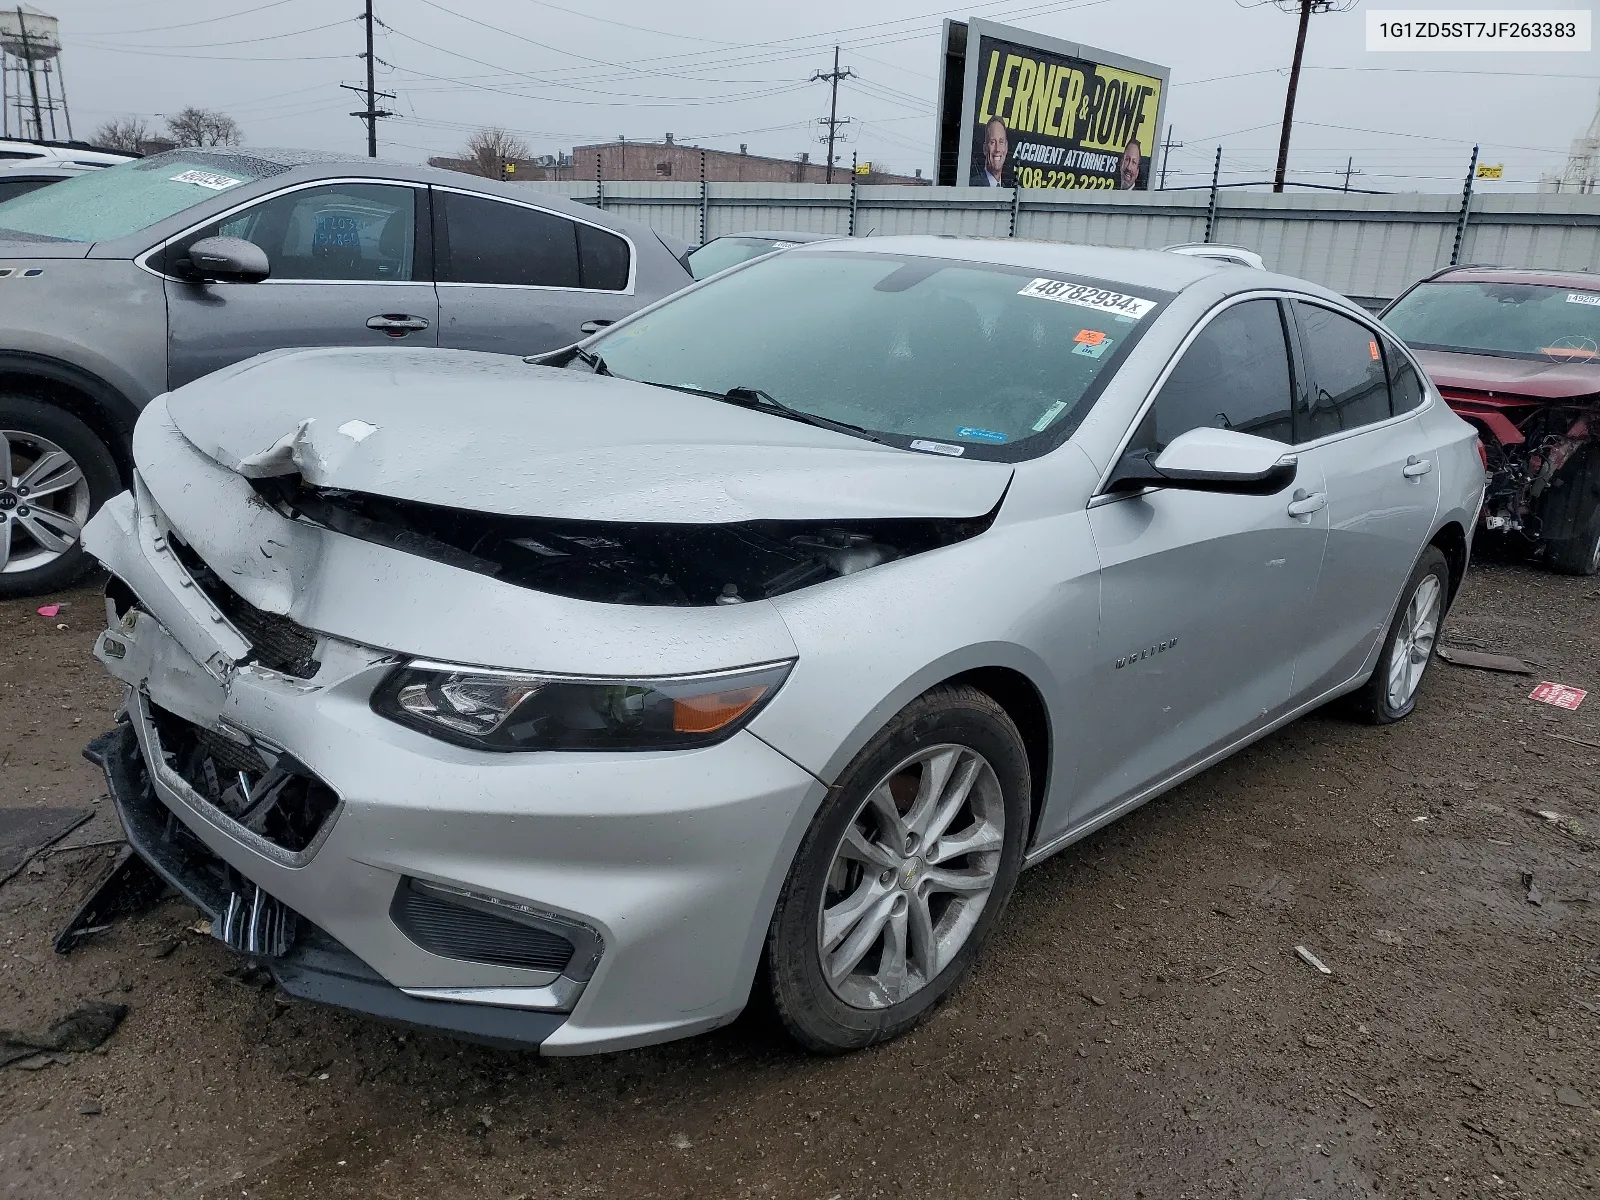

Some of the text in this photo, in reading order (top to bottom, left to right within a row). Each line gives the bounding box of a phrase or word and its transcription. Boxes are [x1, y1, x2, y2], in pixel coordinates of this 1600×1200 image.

[978, 50, 1153, 147] LERNER & ROWE
[1013, 141, 1119, 173] ACCIDENT ATTORNEYS
